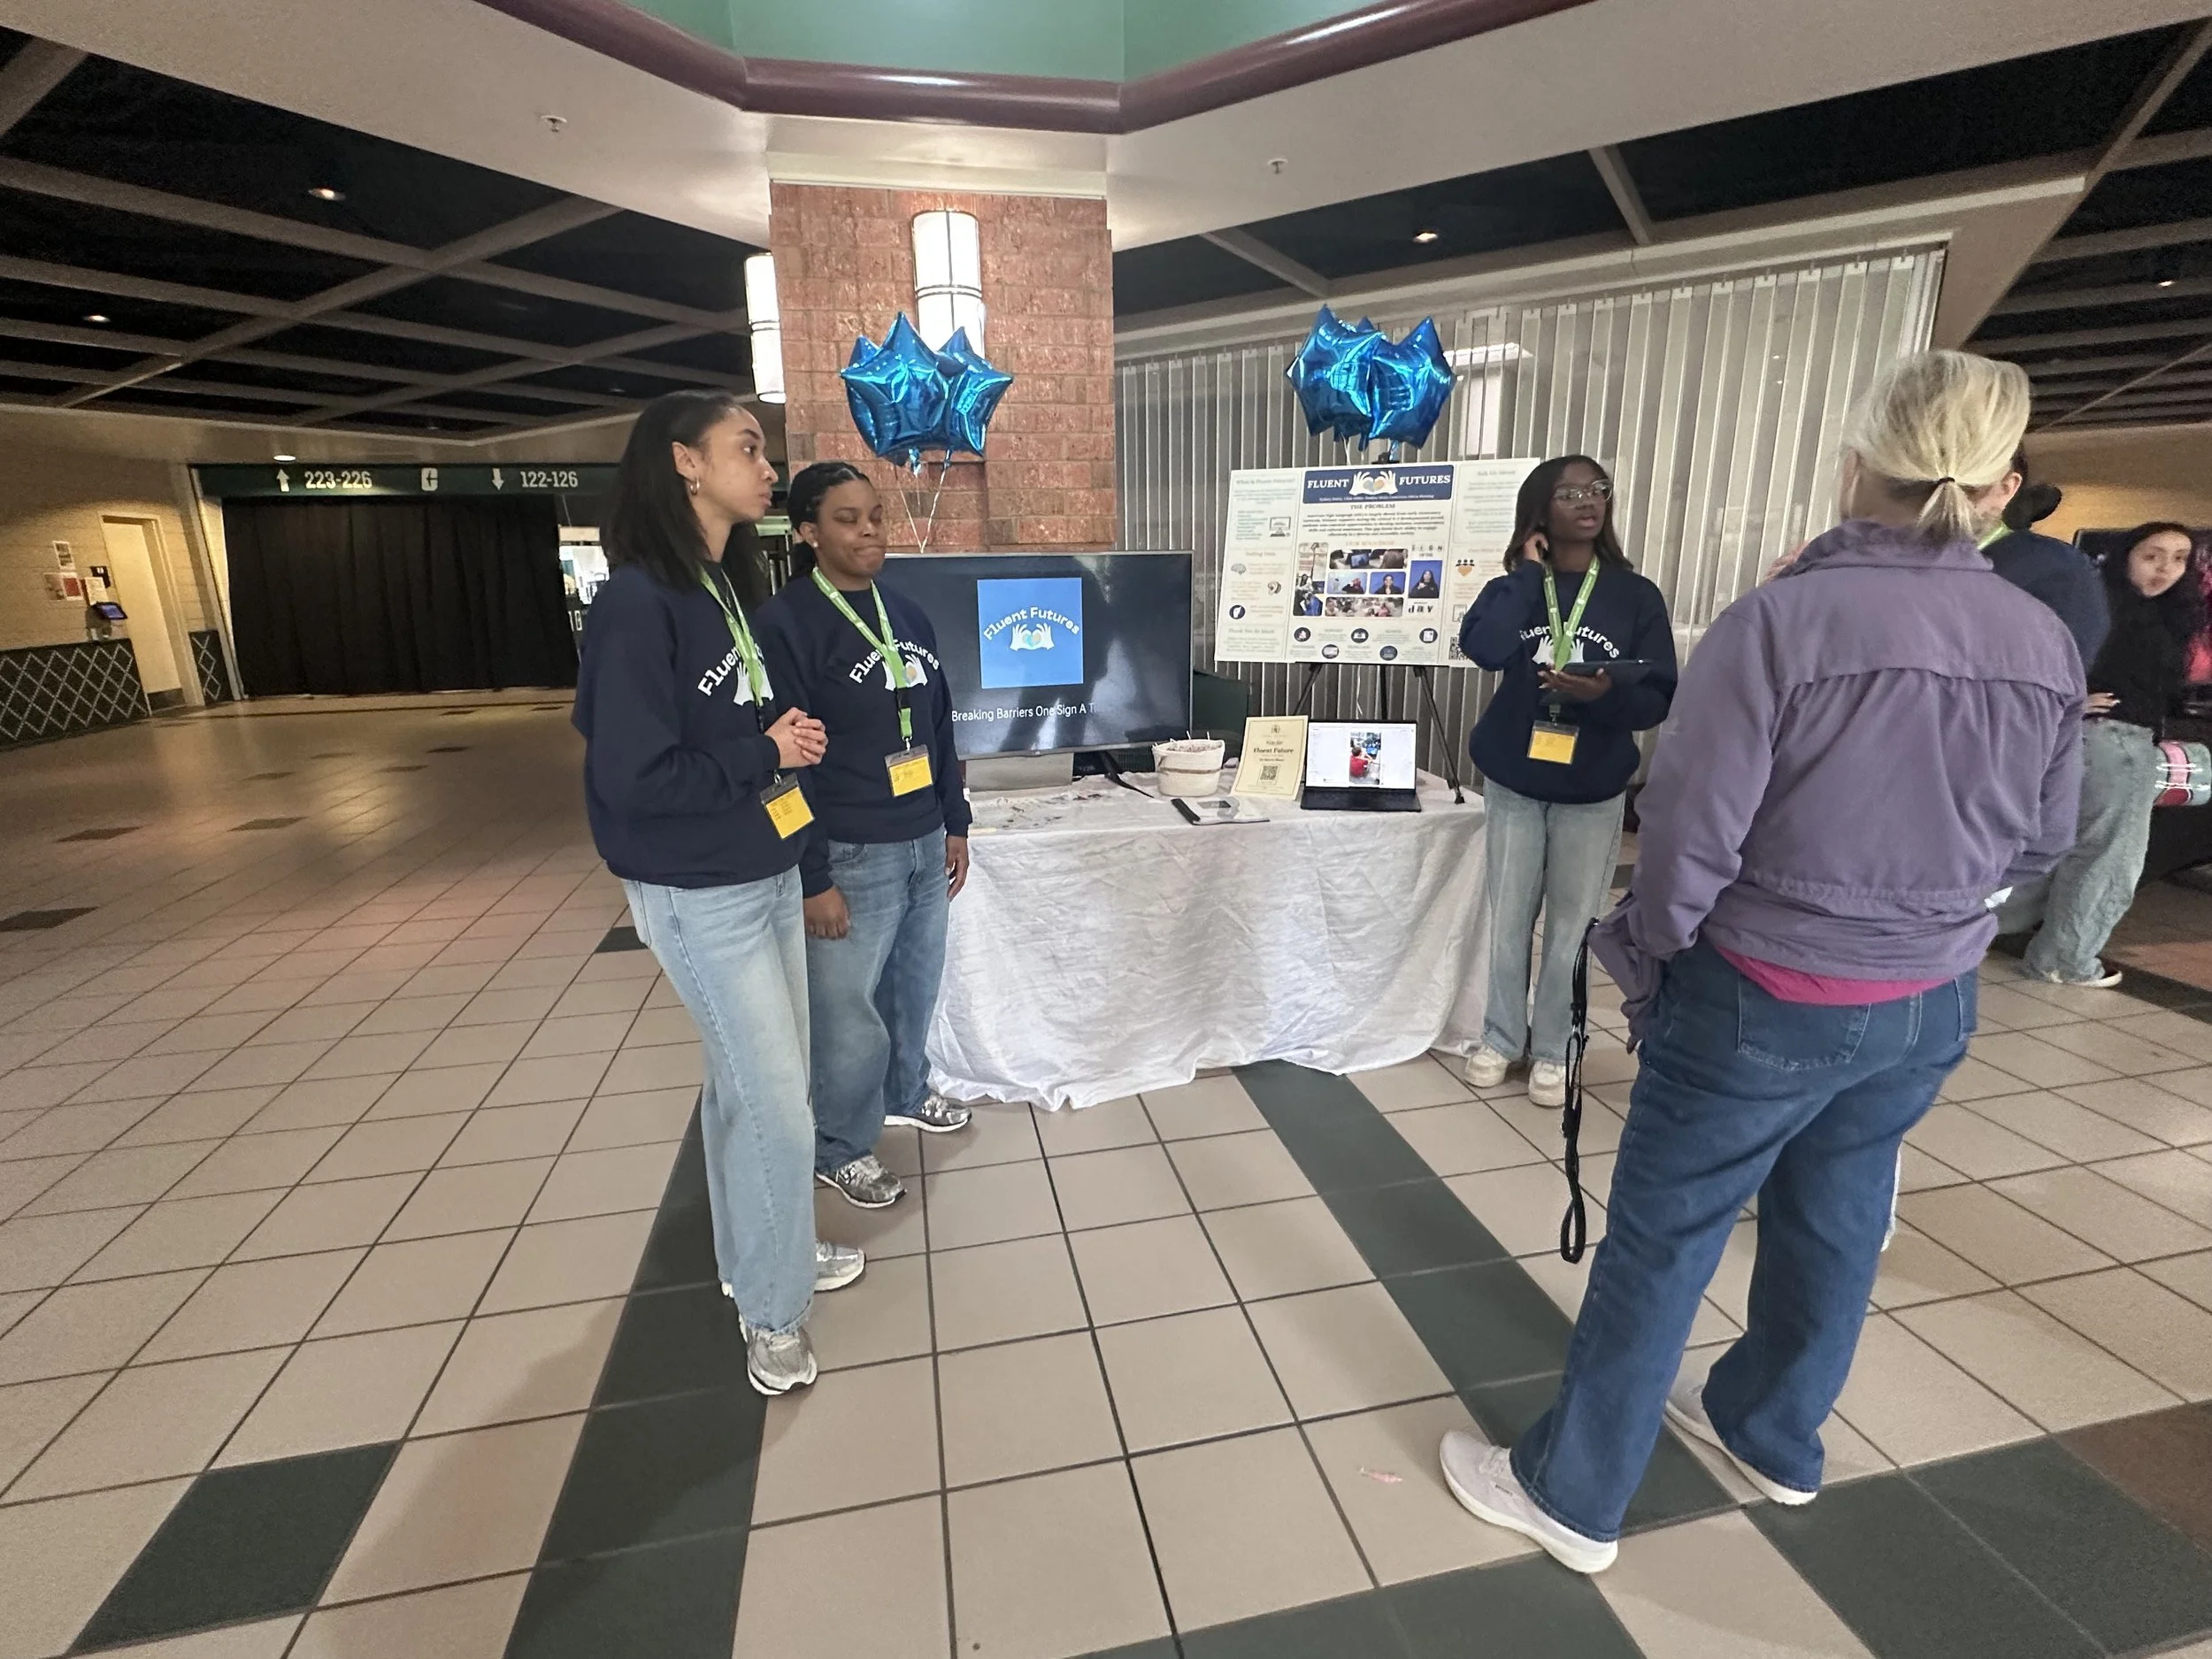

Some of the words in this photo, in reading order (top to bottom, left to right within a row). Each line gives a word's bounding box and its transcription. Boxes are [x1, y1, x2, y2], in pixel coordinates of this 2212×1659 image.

[304, 471, 373, 489] 223-226
[520, 471, 578, 488] 122-126
[1307, 479, 1349, 489] FLUENT
[1399, 474, 1451, 486] FUTURES
[983, 609, 1027, 641] Fluent
[1030, 606, 1079, 635] Futures
[697, 646, 741, 696] Fluen
[849, 649, 883, 684] Flue
[951, 709, 995, 722] Breaking
[996, 707, 1033, 719] Barriers
[1035, 704, 1055, 717] One
[1056, 704, 1077, 718] Sign
[1079, 703, 1087, 714] A
